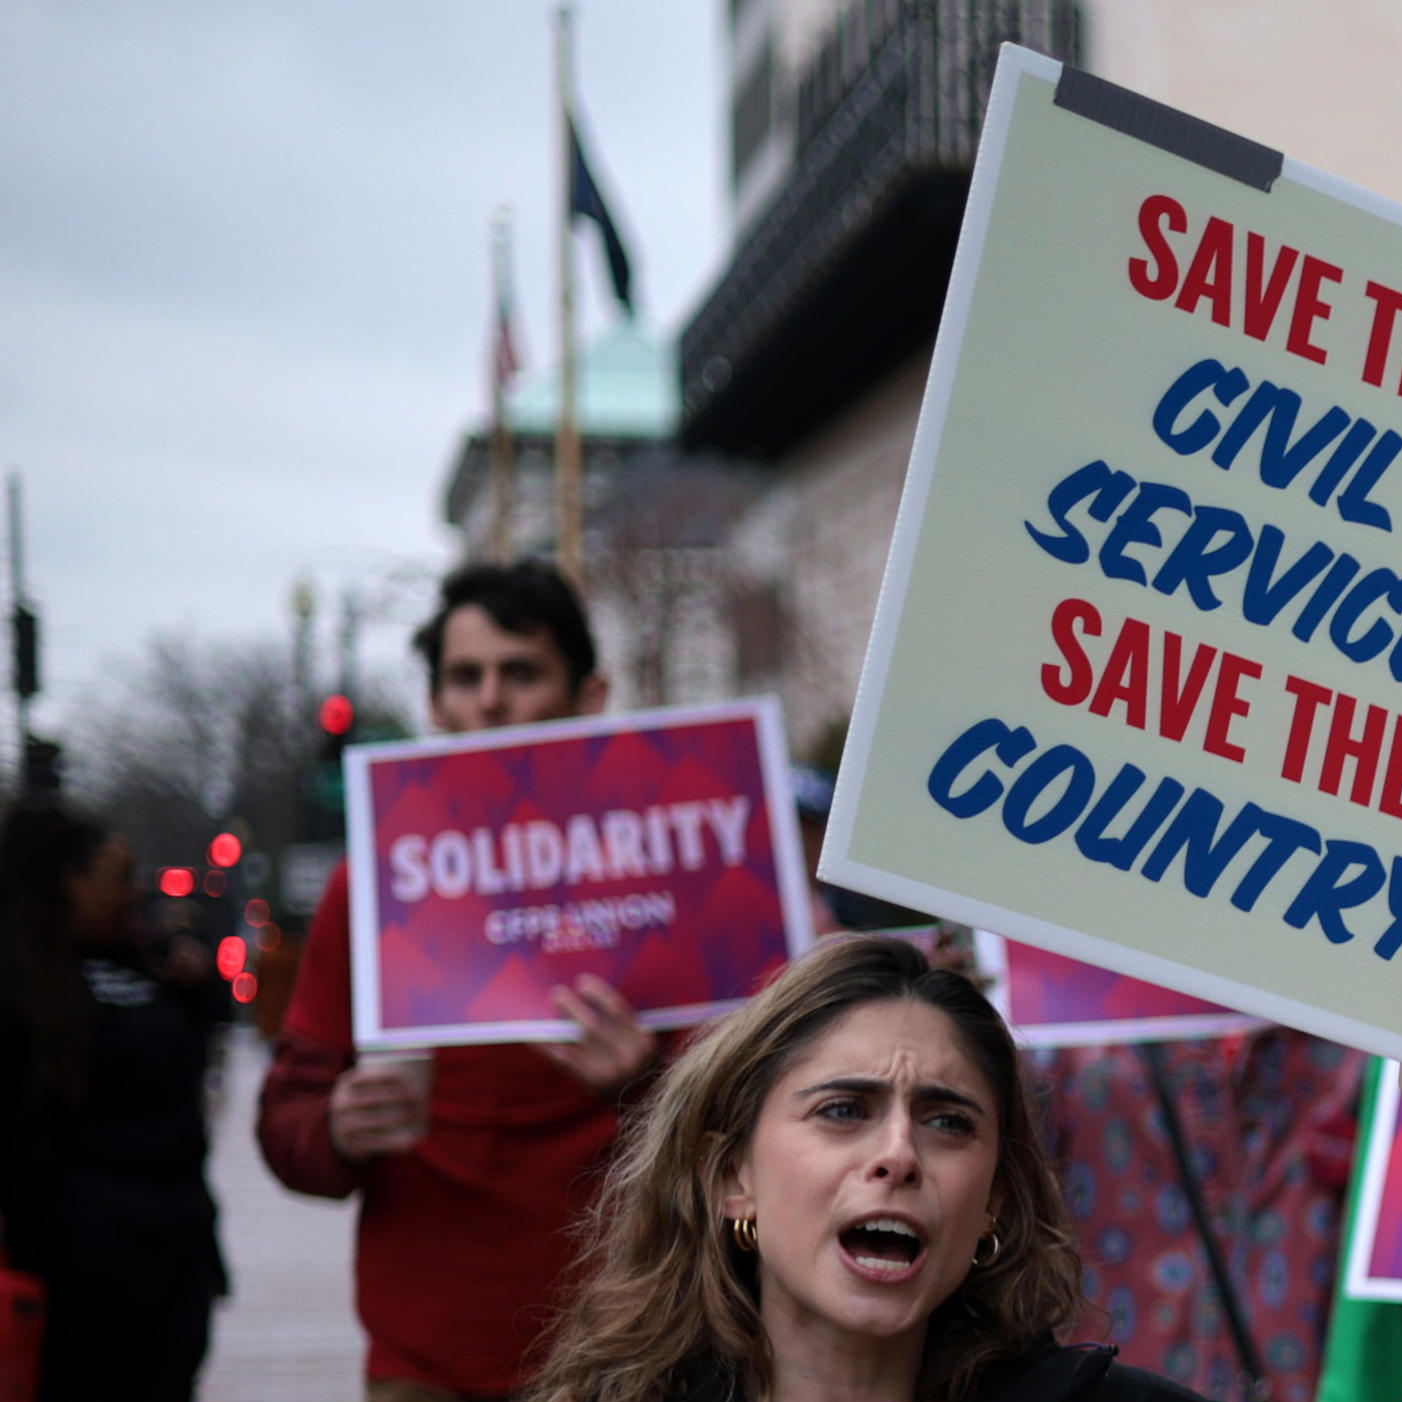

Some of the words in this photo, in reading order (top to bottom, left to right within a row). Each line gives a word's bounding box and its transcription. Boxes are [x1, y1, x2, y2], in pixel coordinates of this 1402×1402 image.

[1128, 194, 1344, 366] SAVE
[1041, 598, 1263, 764] SAVE
[389, 796, 750, 902] SOLIDARITY
[563, 889, 677, 930] UNION
